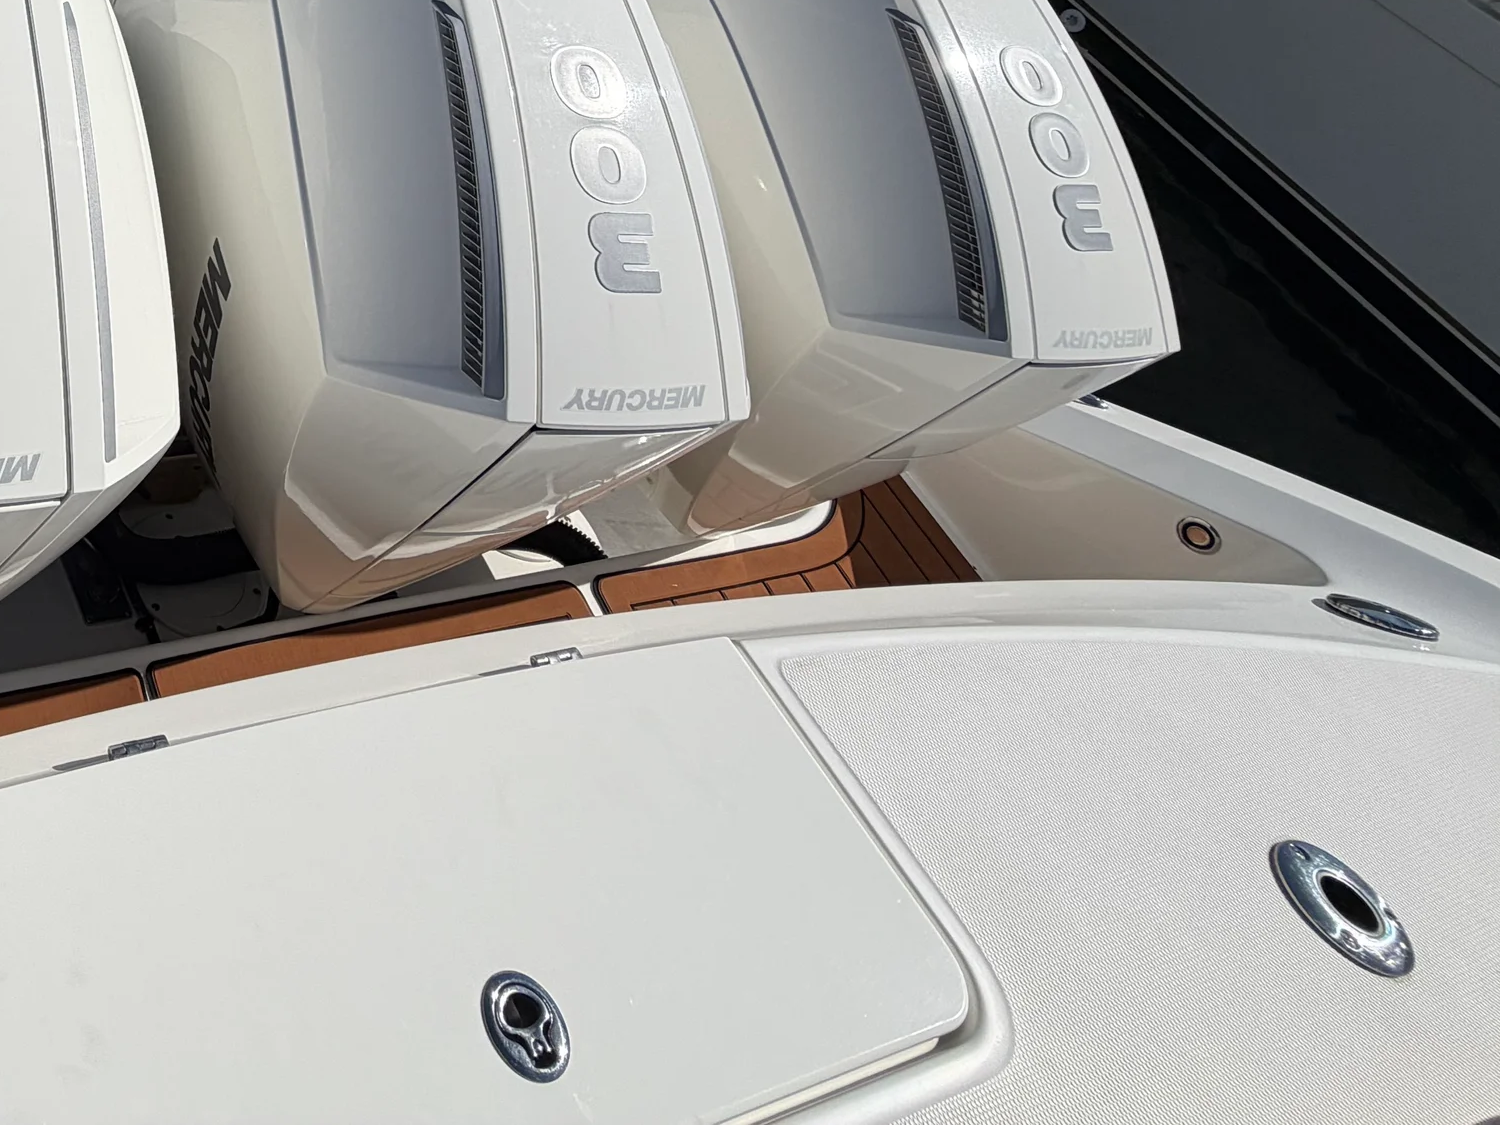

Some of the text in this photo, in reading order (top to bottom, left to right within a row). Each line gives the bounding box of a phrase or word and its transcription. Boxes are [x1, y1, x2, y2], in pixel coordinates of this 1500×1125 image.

[550, 45, 661, 293] 300
[999, 45, 1113, 252] 300
[1053, 327, 1152, 349] MERCURY
[562, 385, 705, 411] MERCURY
